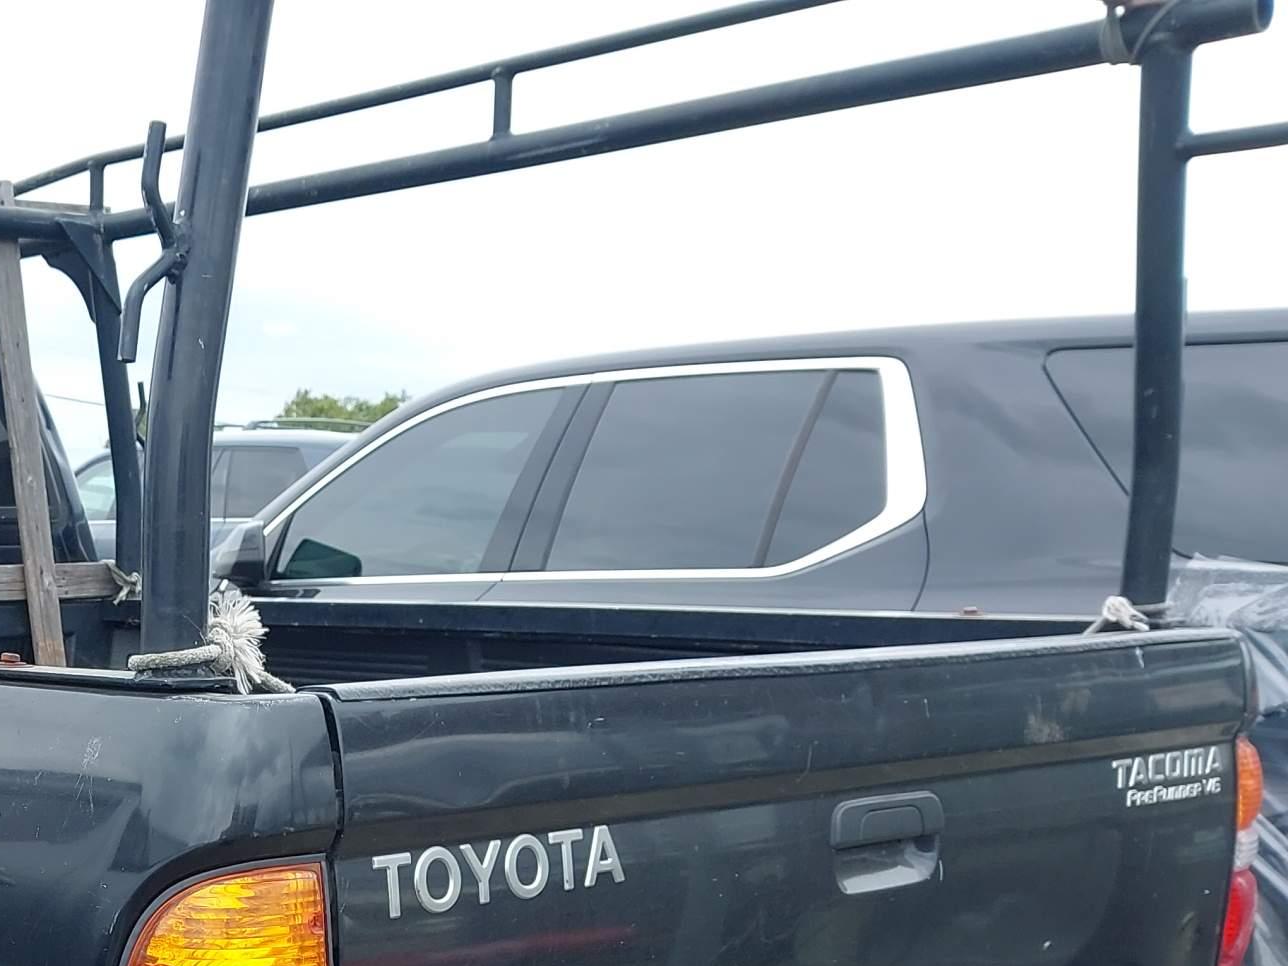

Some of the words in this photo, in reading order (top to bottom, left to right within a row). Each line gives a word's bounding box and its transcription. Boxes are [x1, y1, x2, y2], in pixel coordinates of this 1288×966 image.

[1112, 746, 1223, 789] TACOMA
[1202, 776, 1222, 796] V6
[372, 825, 626, 919] TOYOTA
